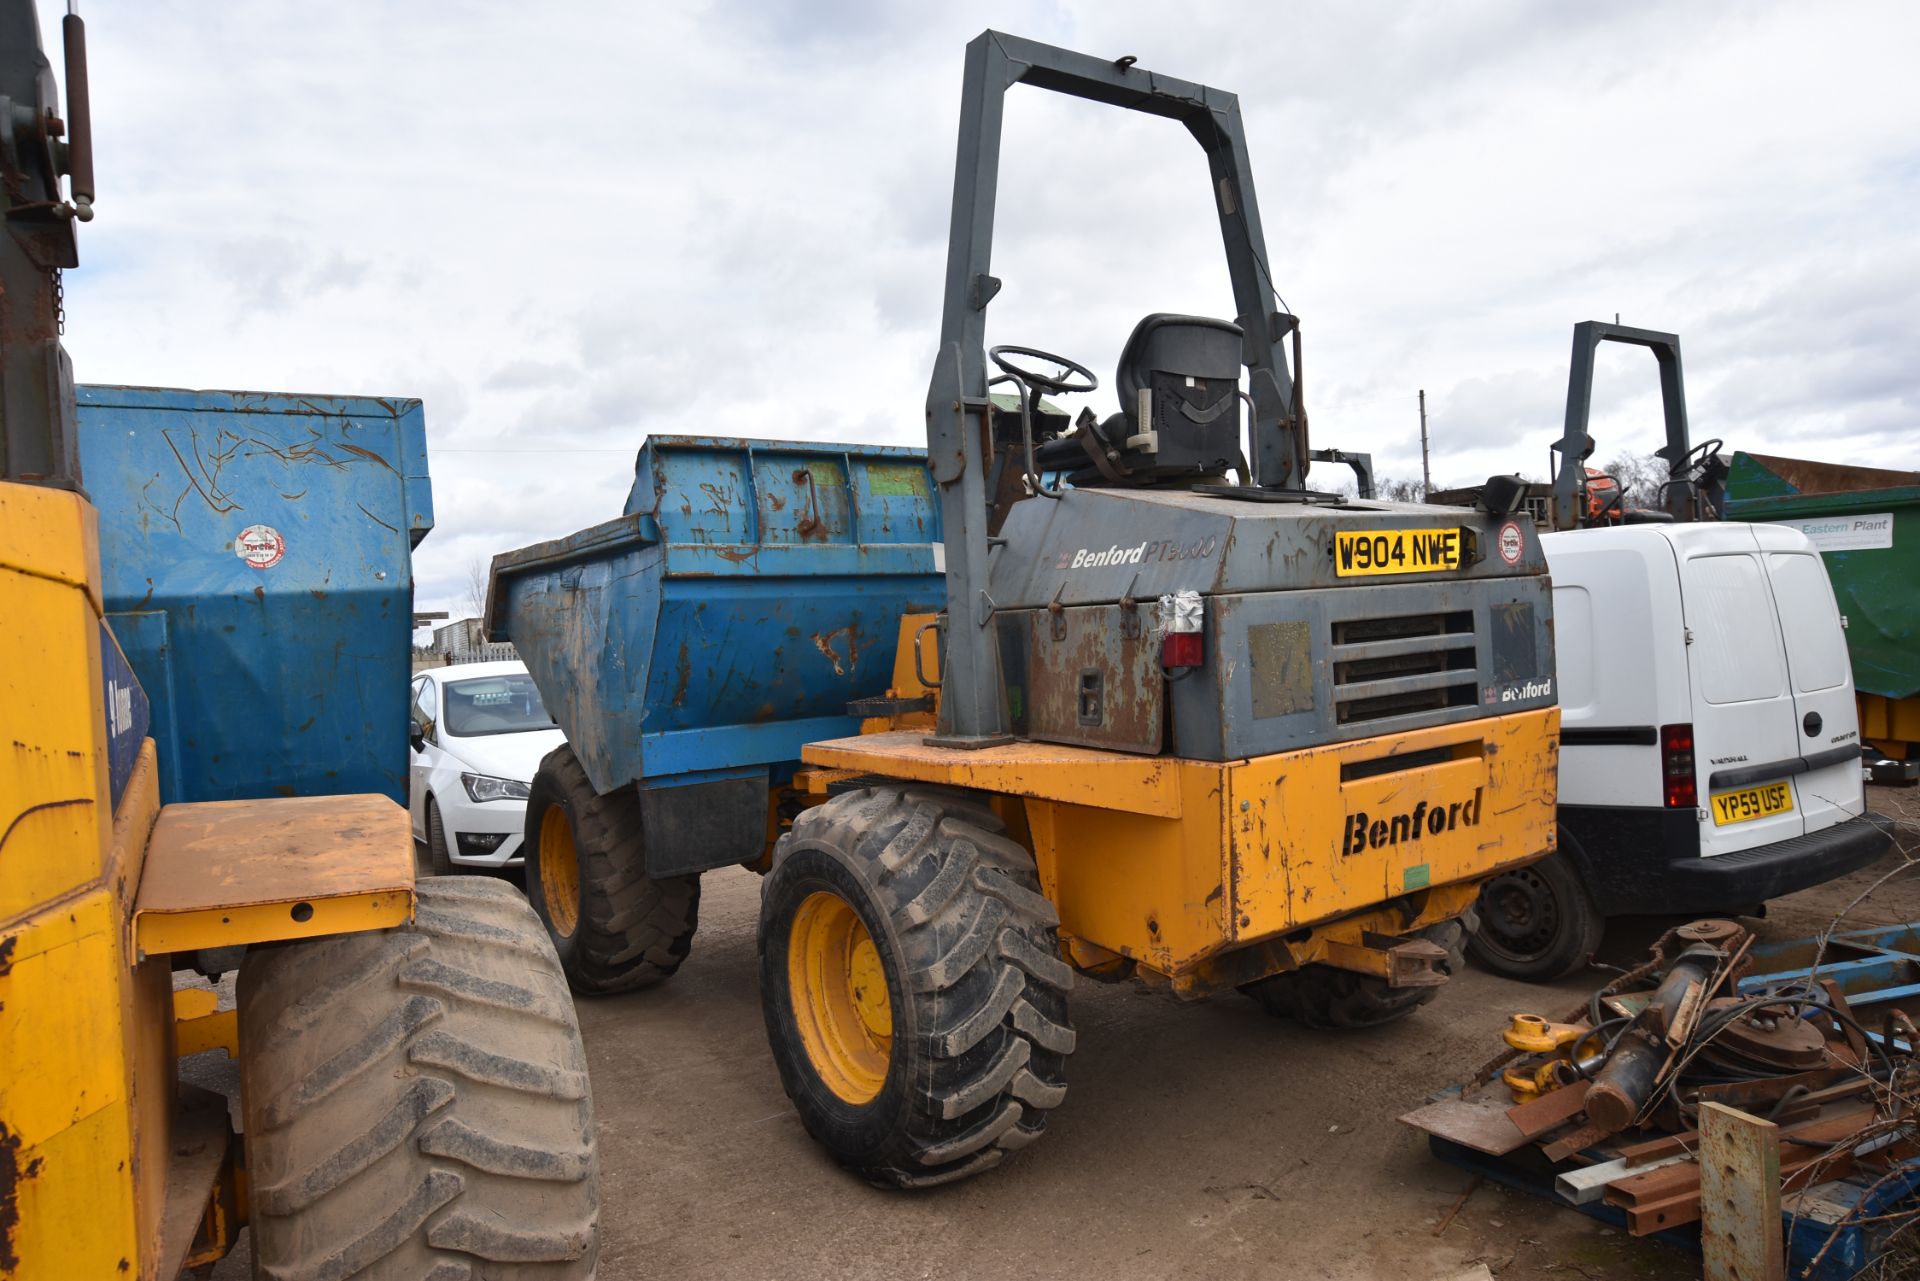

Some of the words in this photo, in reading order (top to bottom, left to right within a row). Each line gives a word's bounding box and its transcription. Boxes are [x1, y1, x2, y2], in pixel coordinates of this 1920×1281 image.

[1802, 523, 1848, 535] Eastern
[1853, 519, 1889, 531] Plant
[1070, 541, 1148, 569] Benford
[1339, 534, 1406, 569] W904
[1413, 533, 1458, 566] NWE
[1717, 791, 1760, 820] YP59
[1760, 785, 1785, 811] USF
[1342, 785, 1484, 857] Benford
